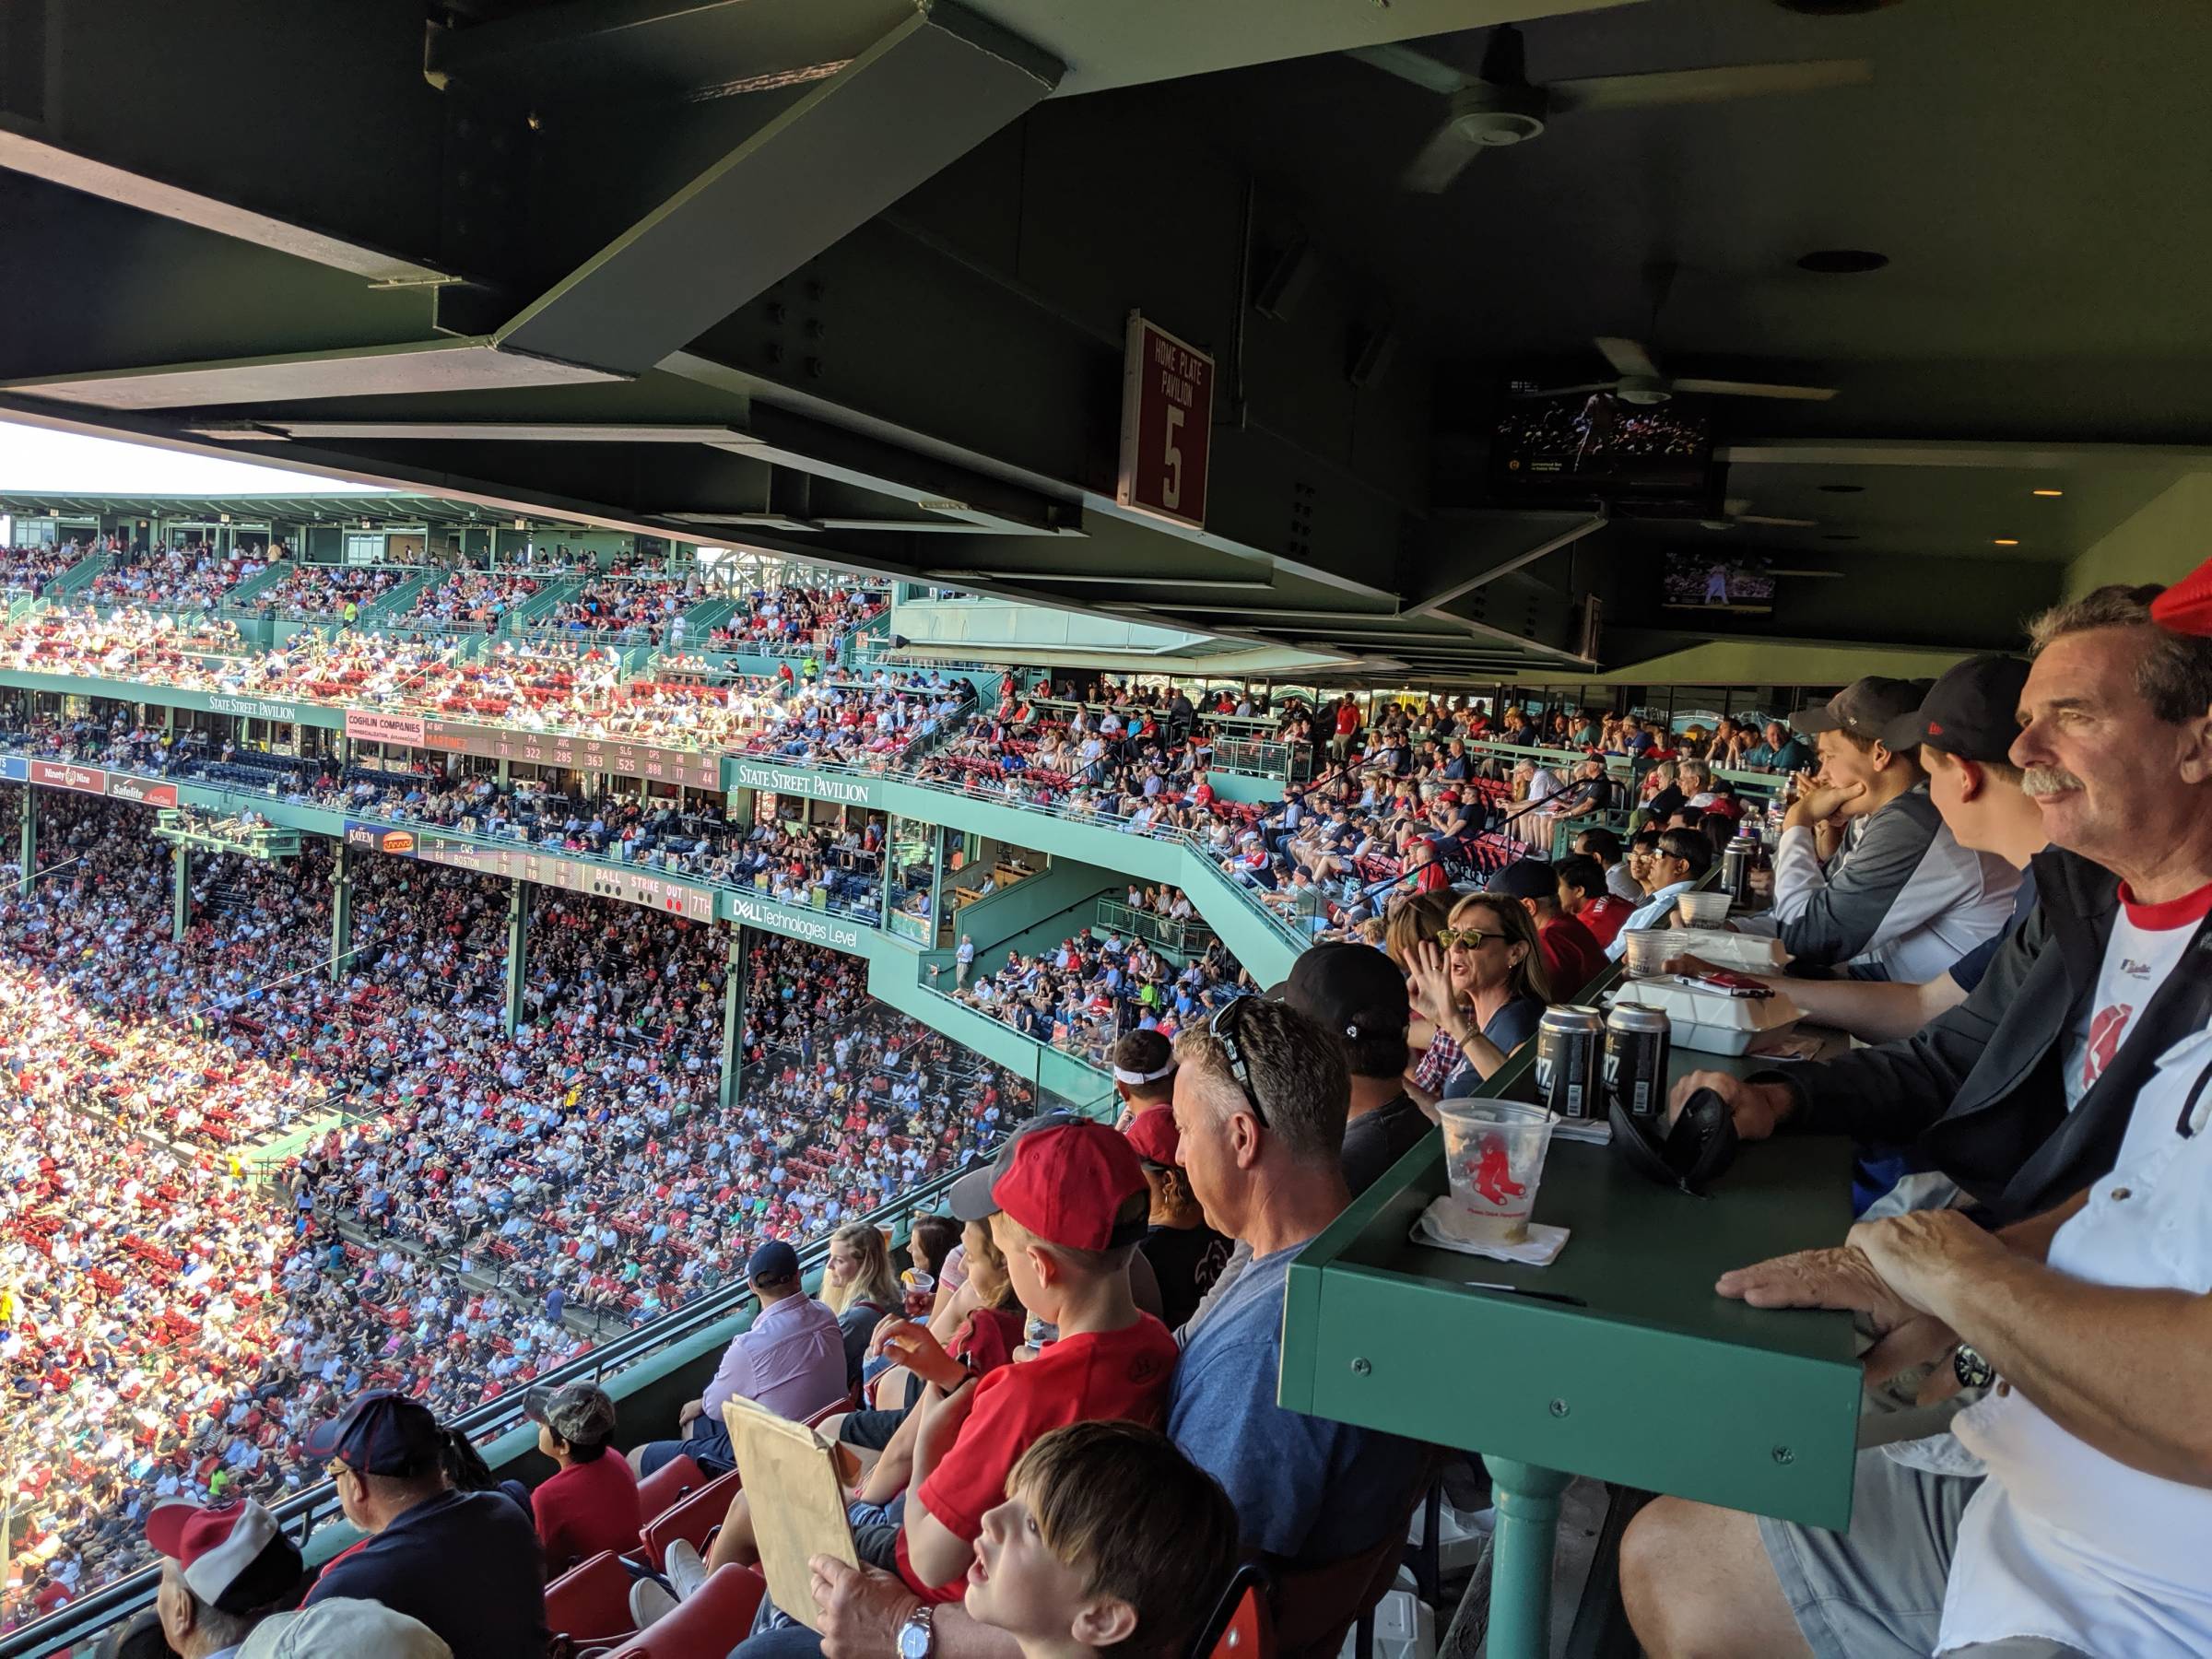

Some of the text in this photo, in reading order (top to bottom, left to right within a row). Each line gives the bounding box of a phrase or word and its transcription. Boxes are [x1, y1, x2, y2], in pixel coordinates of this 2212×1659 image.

[1155, 337, 1202, 385] HOME PLATE
[1161, 371, 1194, 407] PAVILION
[1162, 404, 1184, 510] 5
[209, 695, 230, 712] STATE
[259, 701, 296, 720] PAVILION
[348, 715, 421, 734] COGHLIN COMPANIES
[501, 731, 507, 740] G
[528, 734, 537, 745] PA
[558, 738, 570, 747] AVG
[500, 744, 508, 755] 71
[525, 747, 541, 759] 322
[587, 742, 600, 752] OBP
[619, 746, 632, 756] SLG
[554, 751, 571, 763] .285
[584, 755, 604, 767] .363
[649, 749, 660, 760] OPS
[676, 754, 684, 764] HR
[616, 759, 635, 771] .525
[702, 758, 712, 768] RBI
[44, 768, 65, 782] Ninety
[76, 772, 90, 784] Nine
[676, 768, 684, 780] 17
[702, 773, 712, 784] 44
[112, 784, 144, 799] Safelite
[739, 765, 770, 787] STATE
[813, 775, 870, 804] PAVILION
[348, 830, 374, 849] KAYEM
[435, 839, 444, 849] 39
[461, 843, 475, 855] CWS
[502, 851, 508, 861] 6
[435, 851, 444, 861] 64
[453, 854, 480, 868] BOSTON
[528, 868, 537, 880] 10
[559, 875, 565, 885] 0
[595, 868, 621, 884] BALL
[630, 876, 660, 893] STRIKE
[666, 885, 683, 899] OUT
[692, 896, 712, 915] 7TH
[733, 899, 857, 947] DELL Technologies Level
